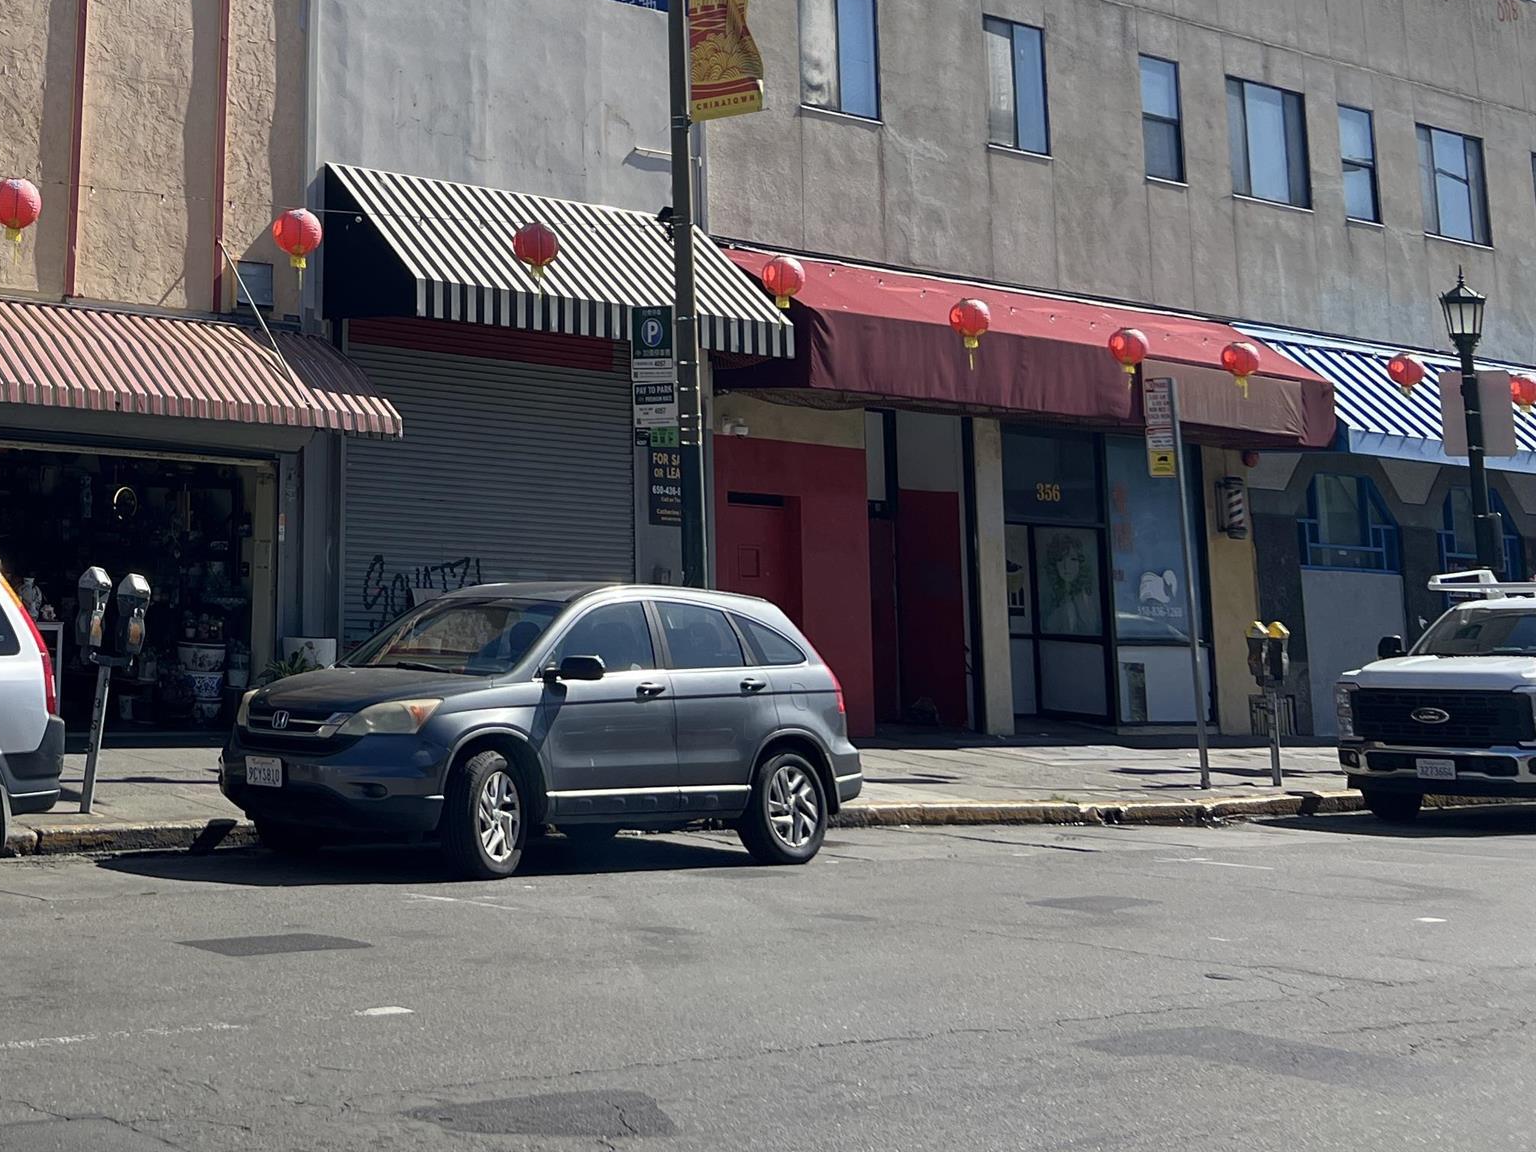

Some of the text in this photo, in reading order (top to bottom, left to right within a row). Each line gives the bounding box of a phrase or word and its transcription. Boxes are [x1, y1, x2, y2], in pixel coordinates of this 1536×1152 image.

[696, 94, 755, 110] CHINATOWN
[647, 321, 659, 343] P
[635, 385, 673, 395] PAY TO PARK
[652, 452, 669, 465] FOR
[654, 468, 664, 478] OR
[1035, 482, 1062, 502] 356
